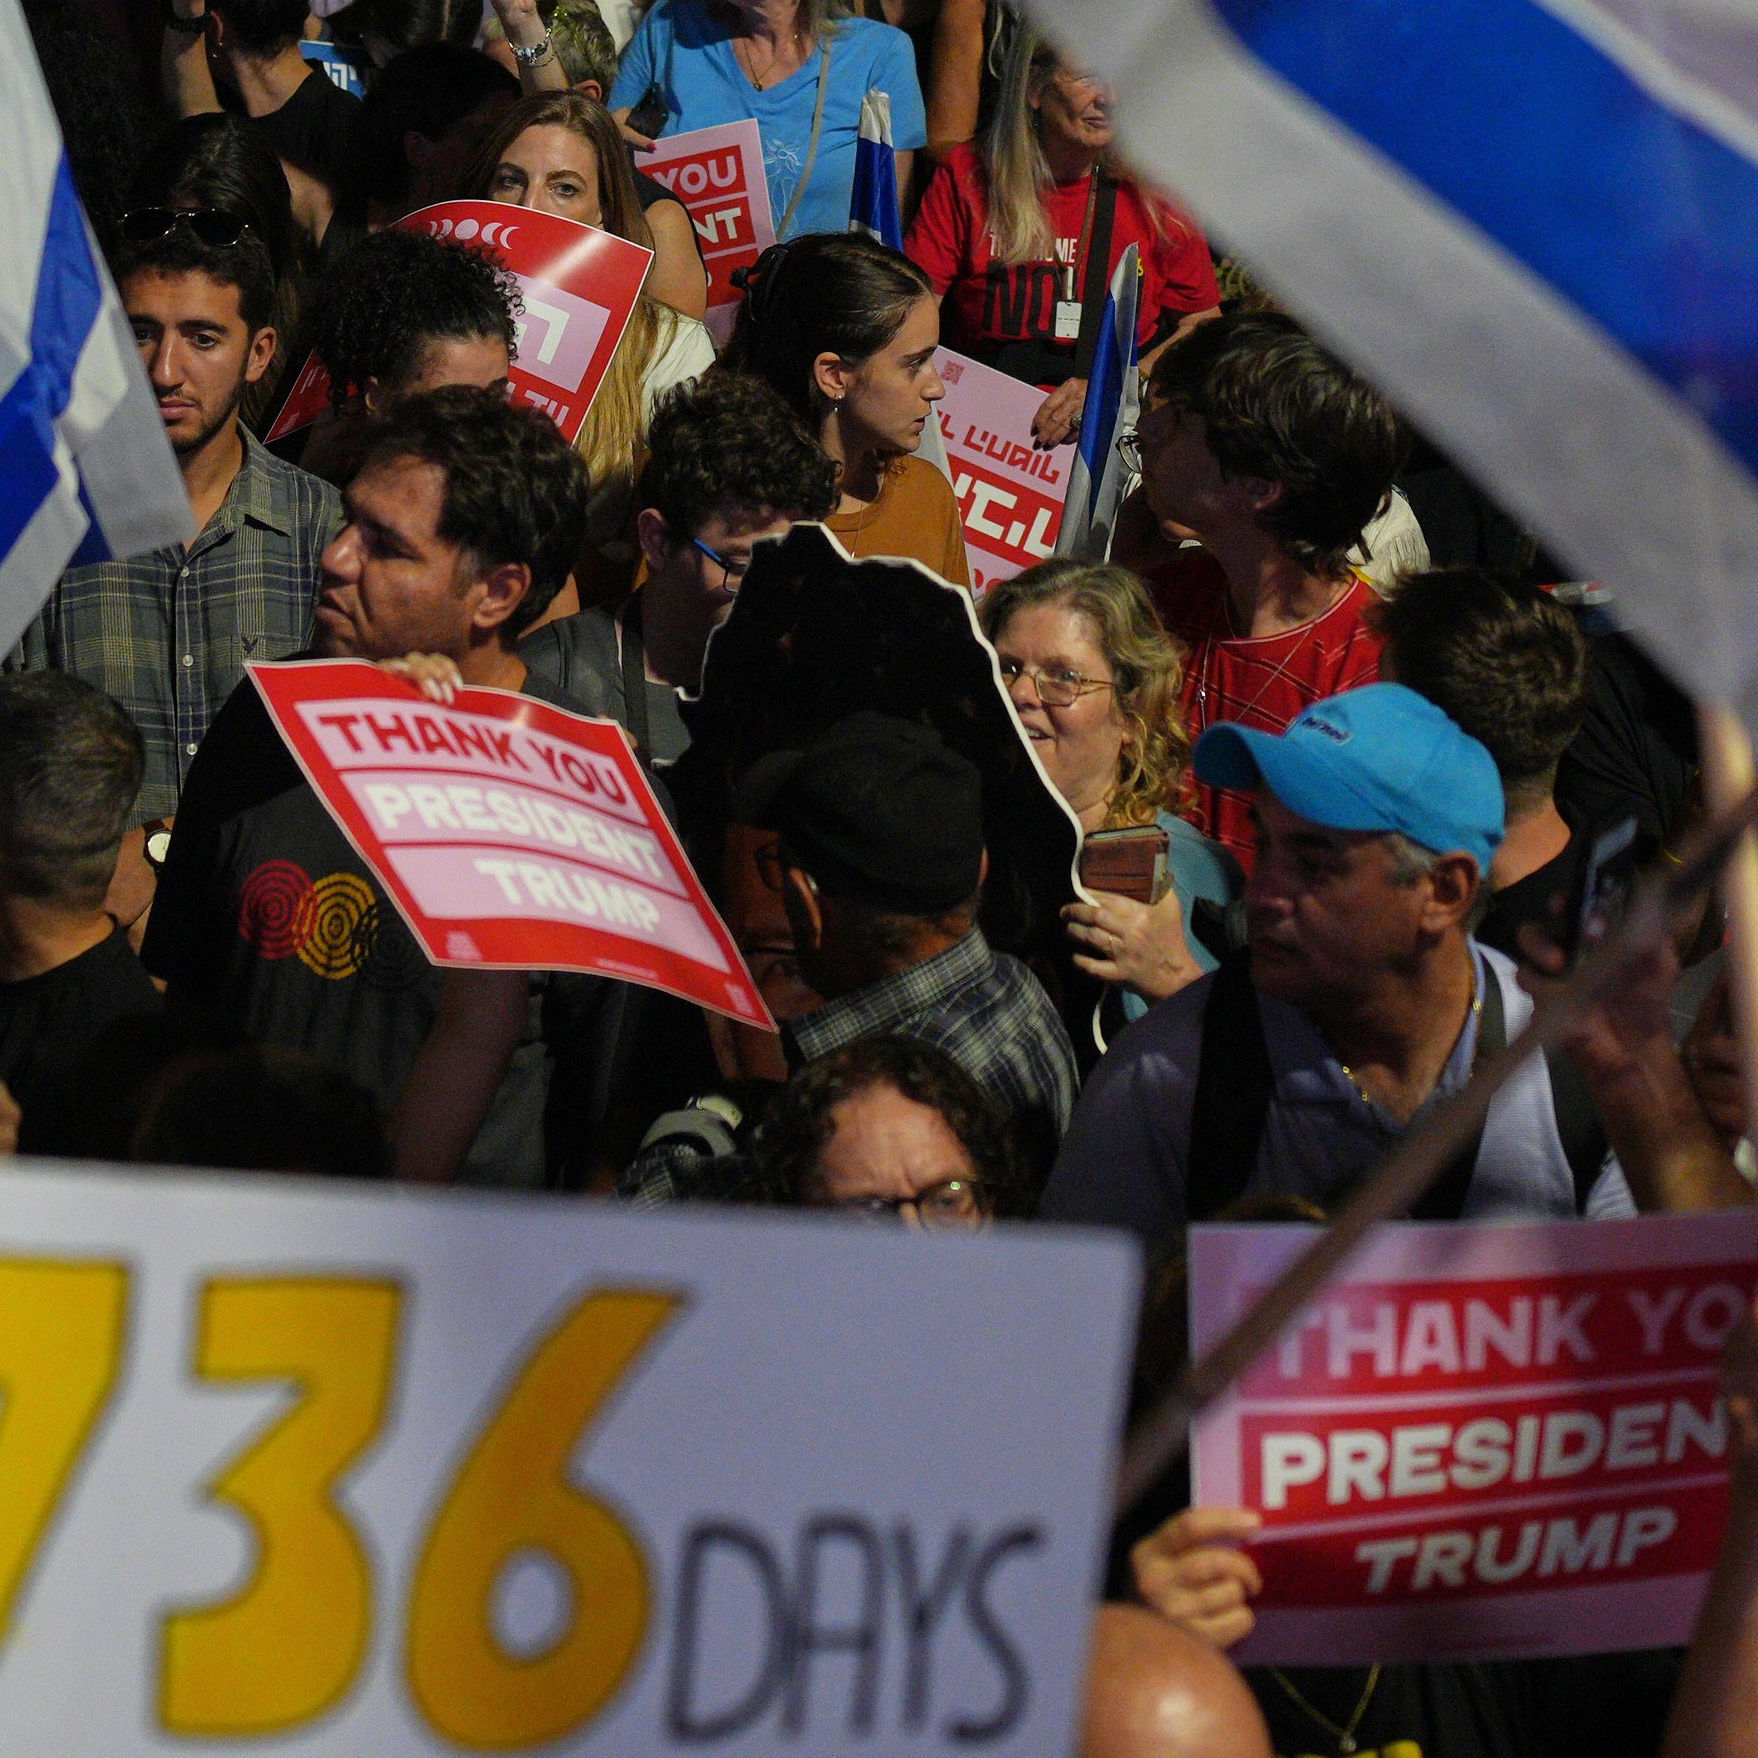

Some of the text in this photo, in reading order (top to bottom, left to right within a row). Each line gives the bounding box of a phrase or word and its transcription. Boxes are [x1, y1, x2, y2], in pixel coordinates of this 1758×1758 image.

[652, 155, 738, 195] YOU
[318, 712, 628, 806] THANK YOU
[364, 783, 666, 880] PRESIDENT
[474, 858, 662, 935] TRUMP
[1275, 1280, 1743, 1381] THANK YO
[1259, 1397, 1732, 1512] PRESIDEN
[1353, 1507, 1679, 1595] TRUMP
[668, 1512, 1051, 1745] DAYS
